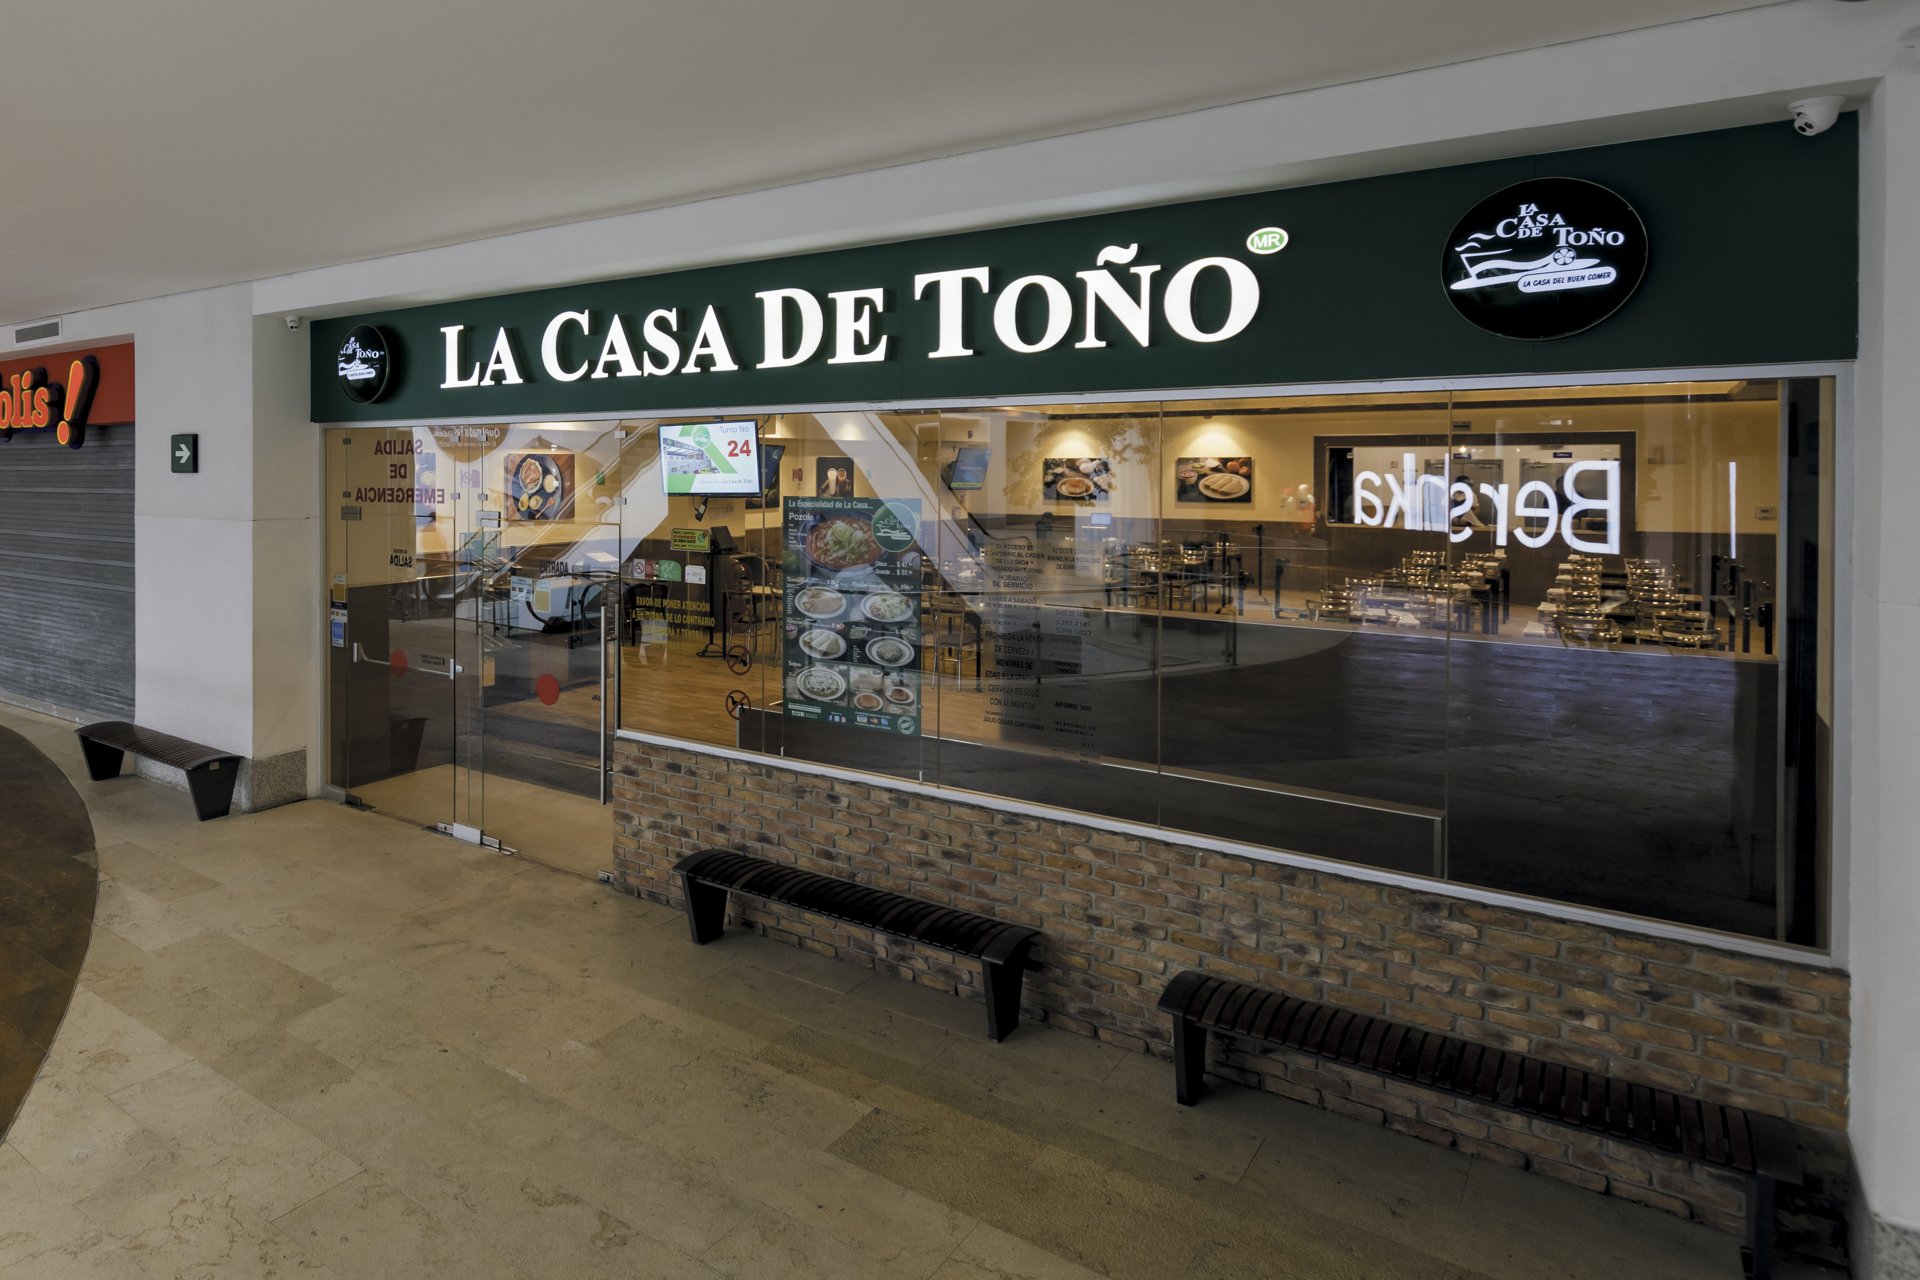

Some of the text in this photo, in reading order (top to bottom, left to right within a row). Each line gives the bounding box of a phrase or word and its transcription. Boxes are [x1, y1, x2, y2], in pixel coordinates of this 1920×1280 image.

[1518, 203, 1539, 216] LA
[1496, 213, 1566, 238] CASA
[1252, 233, 1281, 249] MR
[1517, 226, 1625, 247] DE TOÑO
[1533, 278, 1550, 287] CASA
[1552, 277, 1566, 285] DEL
[1567, 275, 1587, 284] BUEN
[1587, 271, 1612, 281] COMER
[440, 243, 1260, 389] LA CASA DE TOÑO
[356, 349, 380, 360] TOÑO
[720, 425, 751, 435] Turno No.
[727, 439, 752, 457] 24
[788, 500, 796, 508] La
[797, 500, 834, 510] Especialidad
[835, 501, 843, 509] de
[844, 501, 852, 509] La
[788, 513, 814, 521] Pozole
[1025, 552, 1046, 560] ORDEN
[986, 565, 1014, 573] TOMANDO
[998, 575, 1028, 583] HORARIO
[1003, 582, 1033, 590] SERVICIO
[636, 596, 653, 606] FAVOR
[654, 598, 662, 607] DE
[663, 599, 681, 609] PONER
[632, 610, 637, 618] A
[666, 613, 673, 623] DE
[674, 614, 682, 623] LO
[683, 615, 716, 627] CONTRARIO
[985, 631, 1044, 644] PROHIBIDA LA VENTA
[995, 645, 1002, 653] DE
[1003, 646, 1029, 656] CERVEZA
[996, 659, 1034, 670] MENORES DE
[985, 670, 1001, 680] EDAD
[988, 684, 1013, 694] CERVEZA
[1024, 688, 1040, 698] SOLO
[989, 698, 1036, 711] CON ALIMENTOS
[1055, 701, 1078, 710] AFORO
